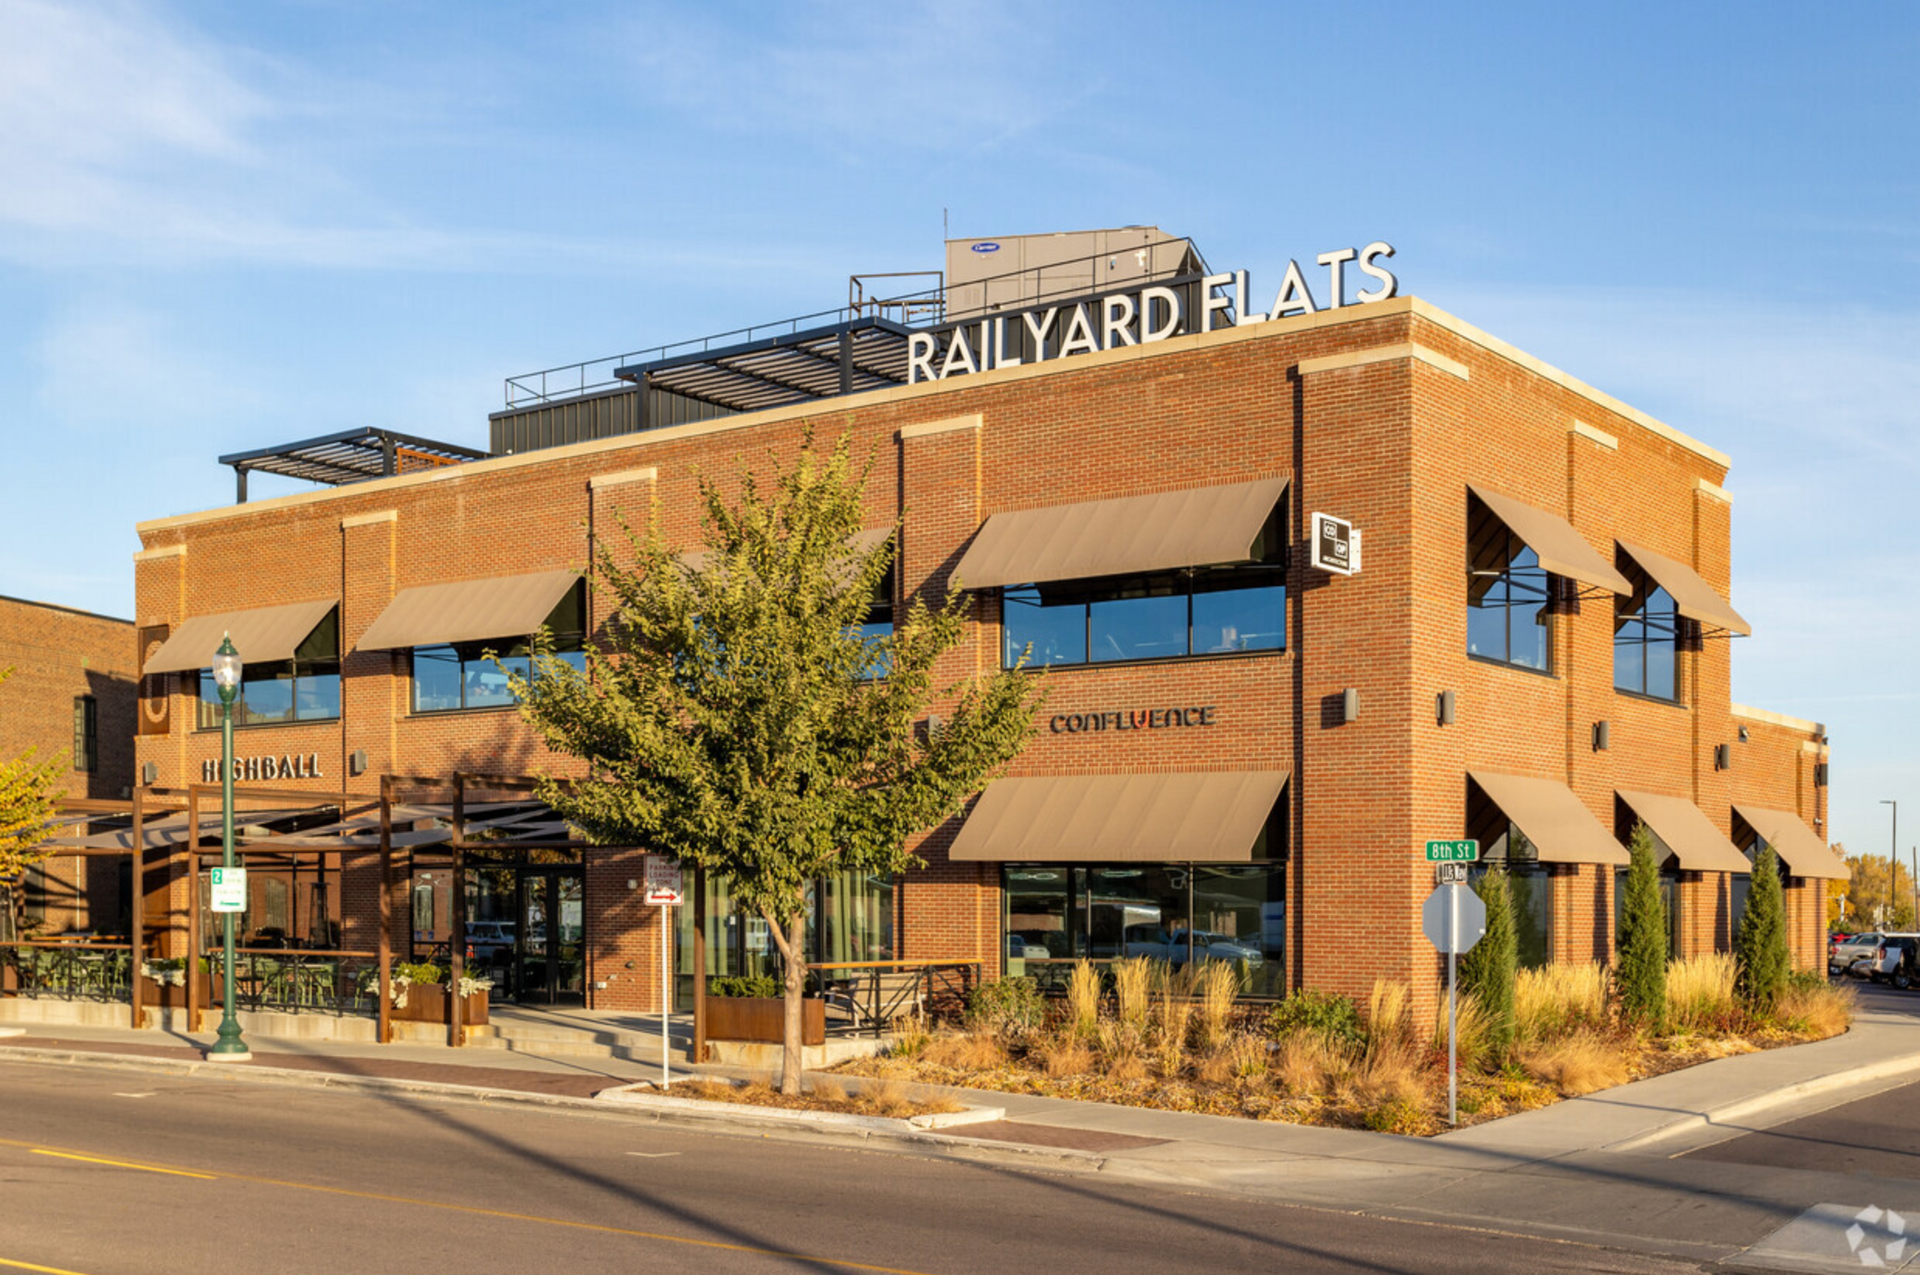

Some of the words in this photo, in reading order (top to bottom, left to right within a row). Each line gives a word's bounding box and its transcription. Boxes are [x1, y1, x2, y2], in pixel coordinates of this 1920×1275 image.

[908, 286, 1184, 384] RAILYARD
[1202, 241, 1397, 332] FLATS
[1049, 705, 1217, 733] CONFLUENCE
[202, 753, 323, 782] HGHBALL
[1432, 843, 1452, 859] 8th
[1457, 843, 1470, 859] St
[214, 871, 221, 882] 2
